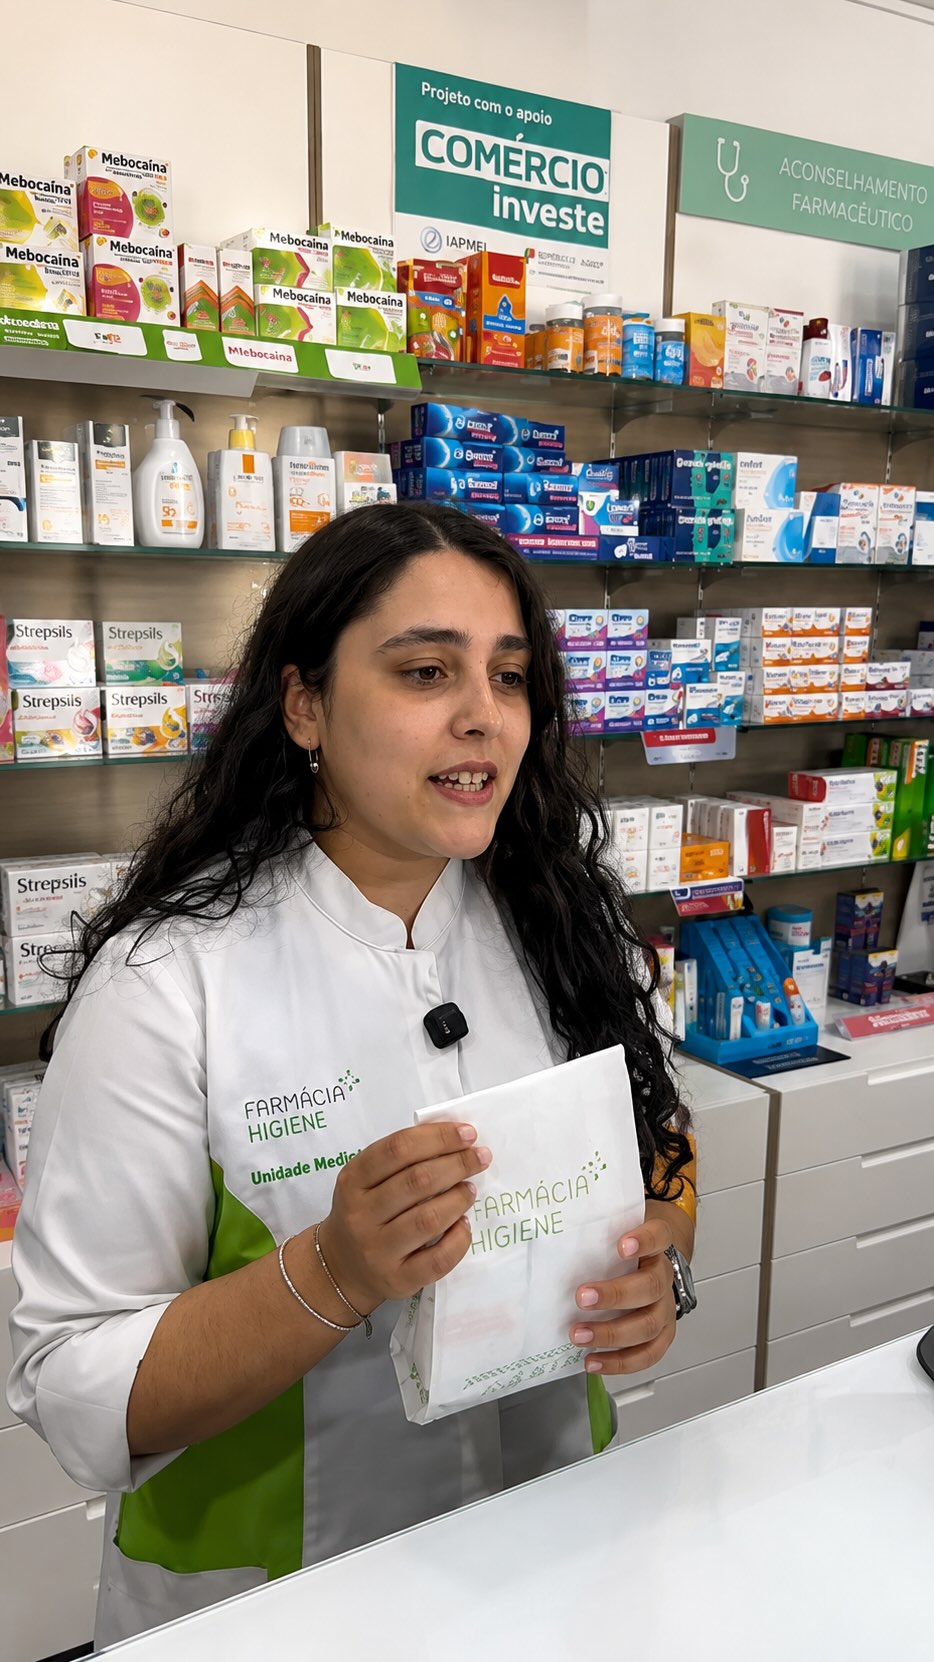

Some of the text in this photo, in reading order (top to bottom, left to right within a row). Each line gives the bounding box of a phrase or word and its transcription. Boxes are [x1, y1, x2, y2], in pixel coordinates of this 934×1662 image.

[421, 81, 553, 126] Projeto com o apoio
[420, 128, 606, 196] COMÉRCIO
[778, 157, 929, 205] ACONSELHAMENTO
[492, 185, 605, 236] investe
[792, 192, 914, 233] FARMACÉUTICO
[15, 624, 73, 641] Strepsils
[108, 626, 163, 642] Strepsils
[22, 693, 82, 711] Strepsils
[111, 691, 168, 709] Strepsils
[244, 1085, 346, 1120] FARMÁCIA
[247, 1110, 328, 1144] HIGIENE
[250, 1148, 362, 1186] Unidade Medic
[473, 1174, 590, 1222] FARMÁCIA
[470, 1210, 564, 1256] HIGIENE
